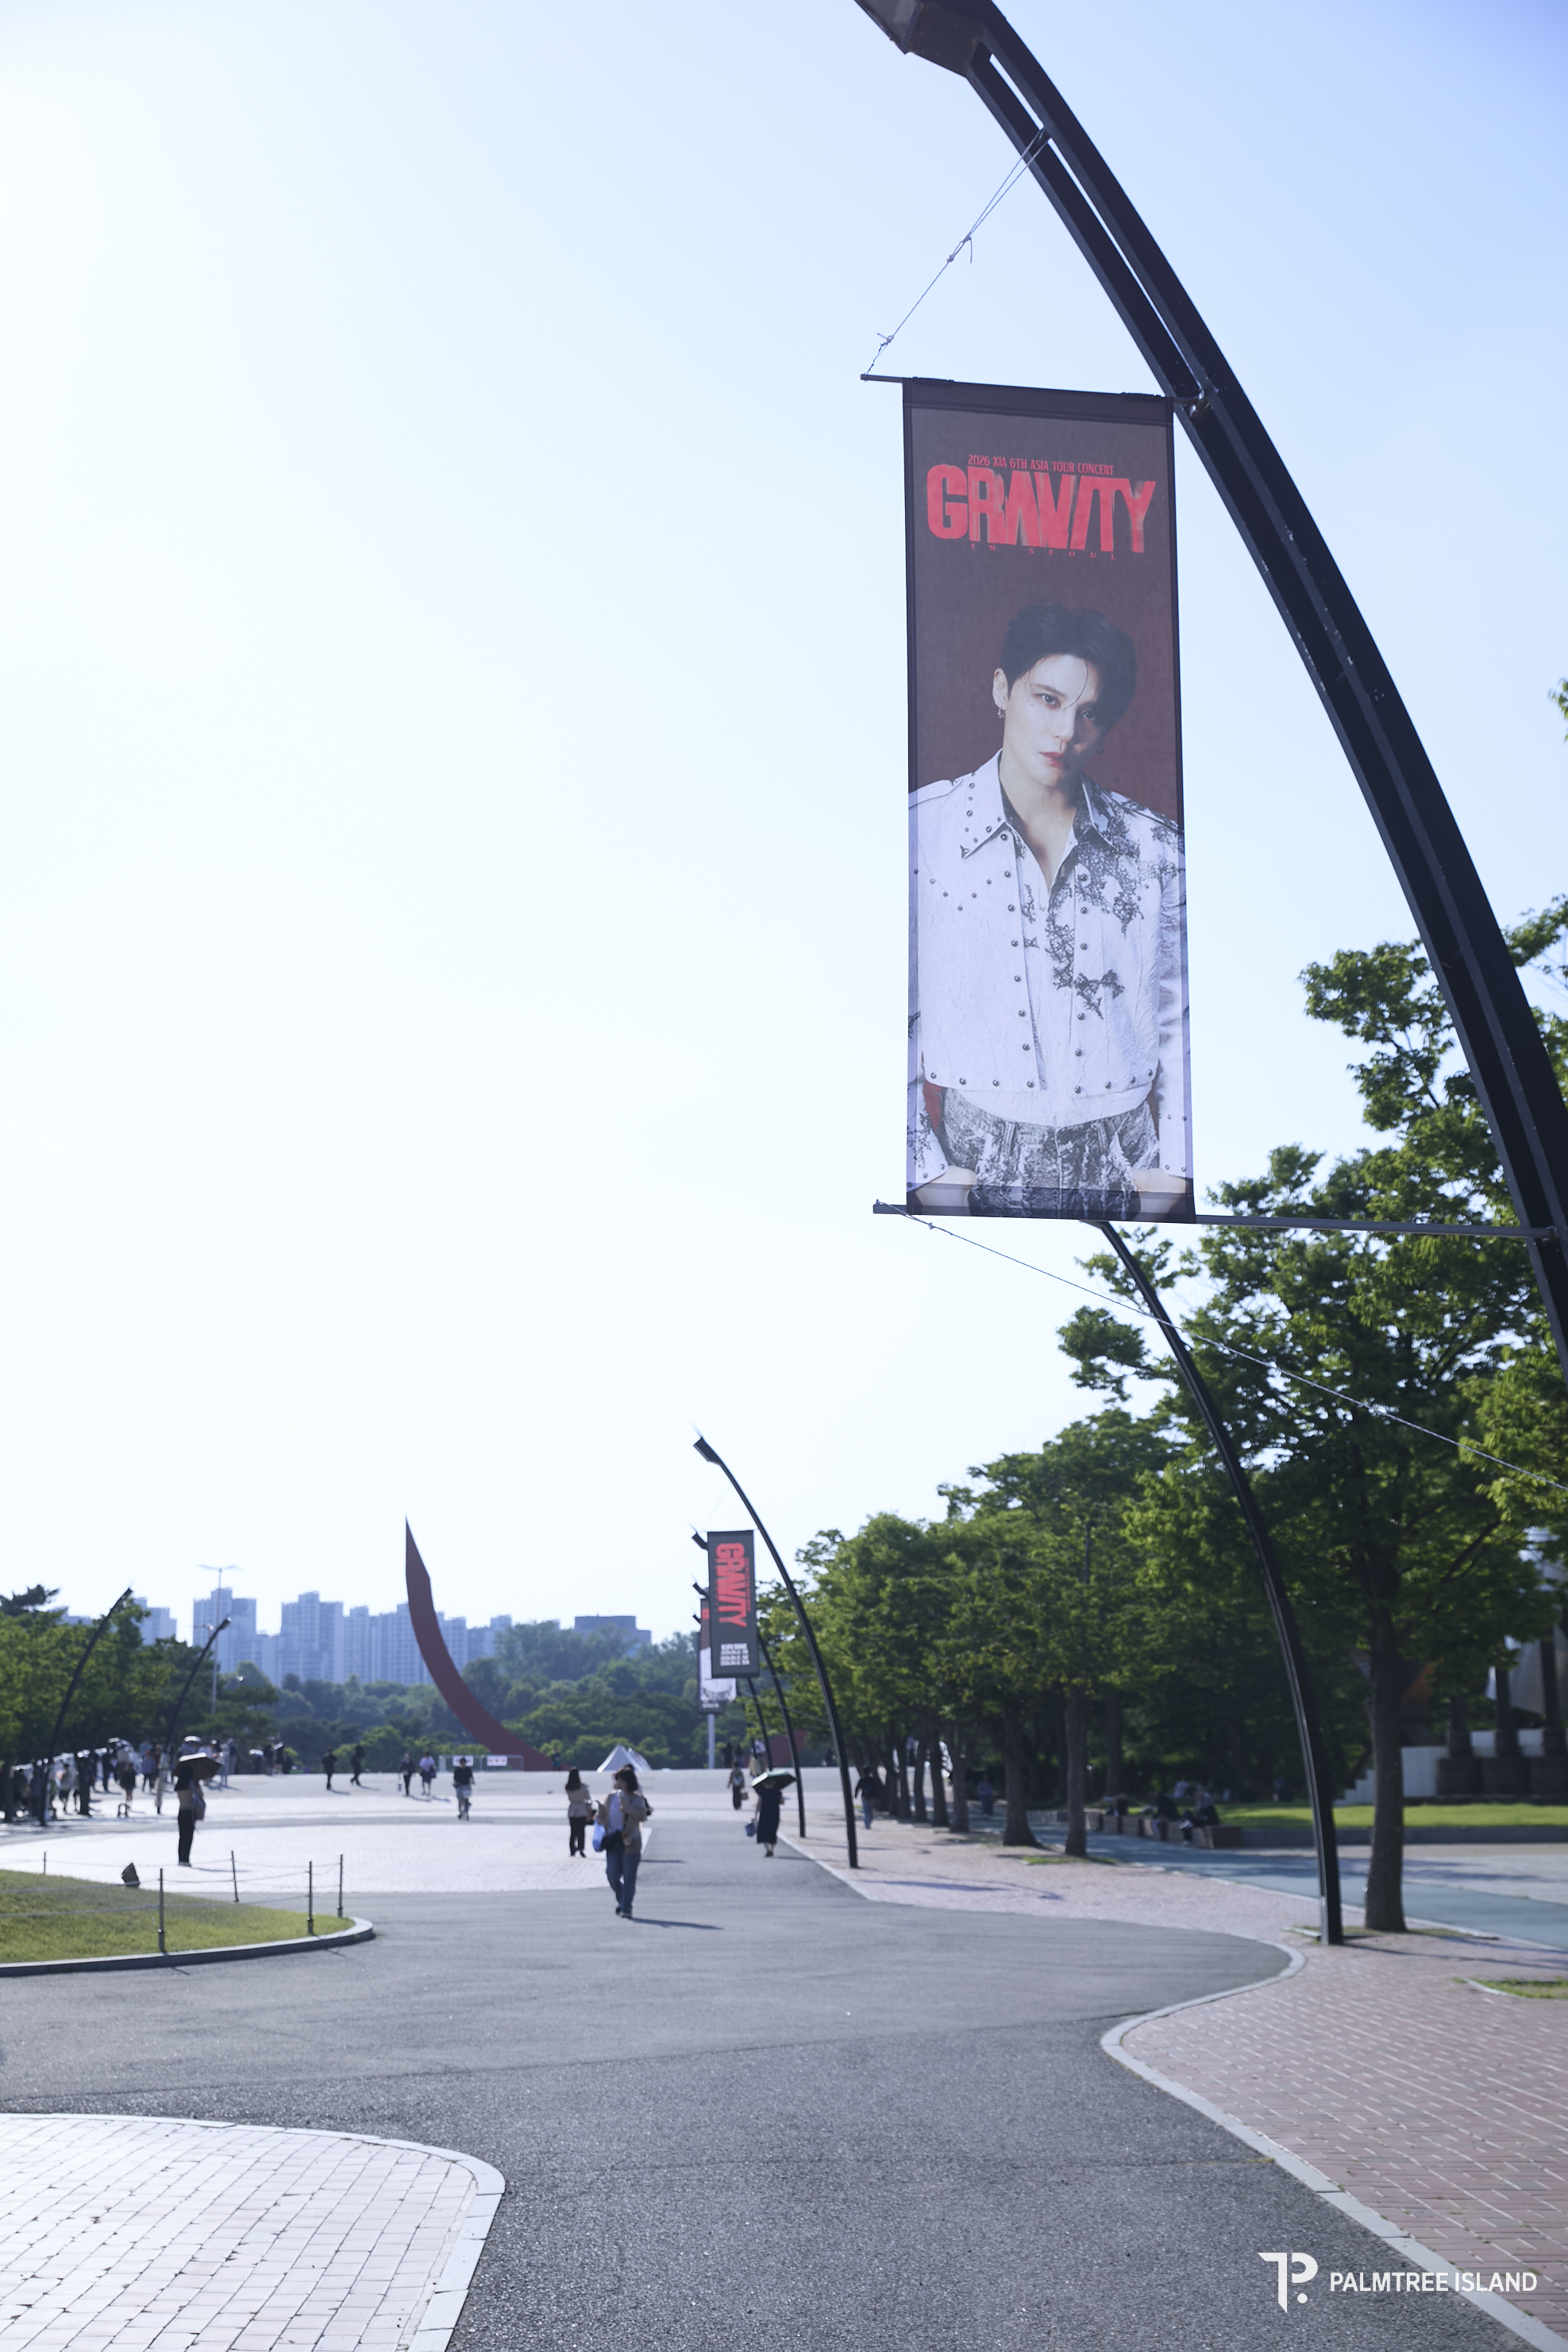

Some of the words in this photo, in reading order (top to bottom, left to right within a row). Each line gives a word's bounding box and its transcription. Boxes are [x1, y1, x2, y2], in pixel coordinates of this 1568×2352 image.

[968, 454, 990, 467] 2026
[992, 456, 1007, 468] XIA
[1009, 457, 1027, 469] 6TH
[1030, 459, 1049, 471] ASIA
[1051, 461, 1075, 473] TOUR
[1077, 462, 1115, 476] CONCERT
[927, 464, 1157, 553] GRAVITY
[1028, 548, 1116, 561] SEOUL
[716, 1543, 747, 1628] GRAVITY
